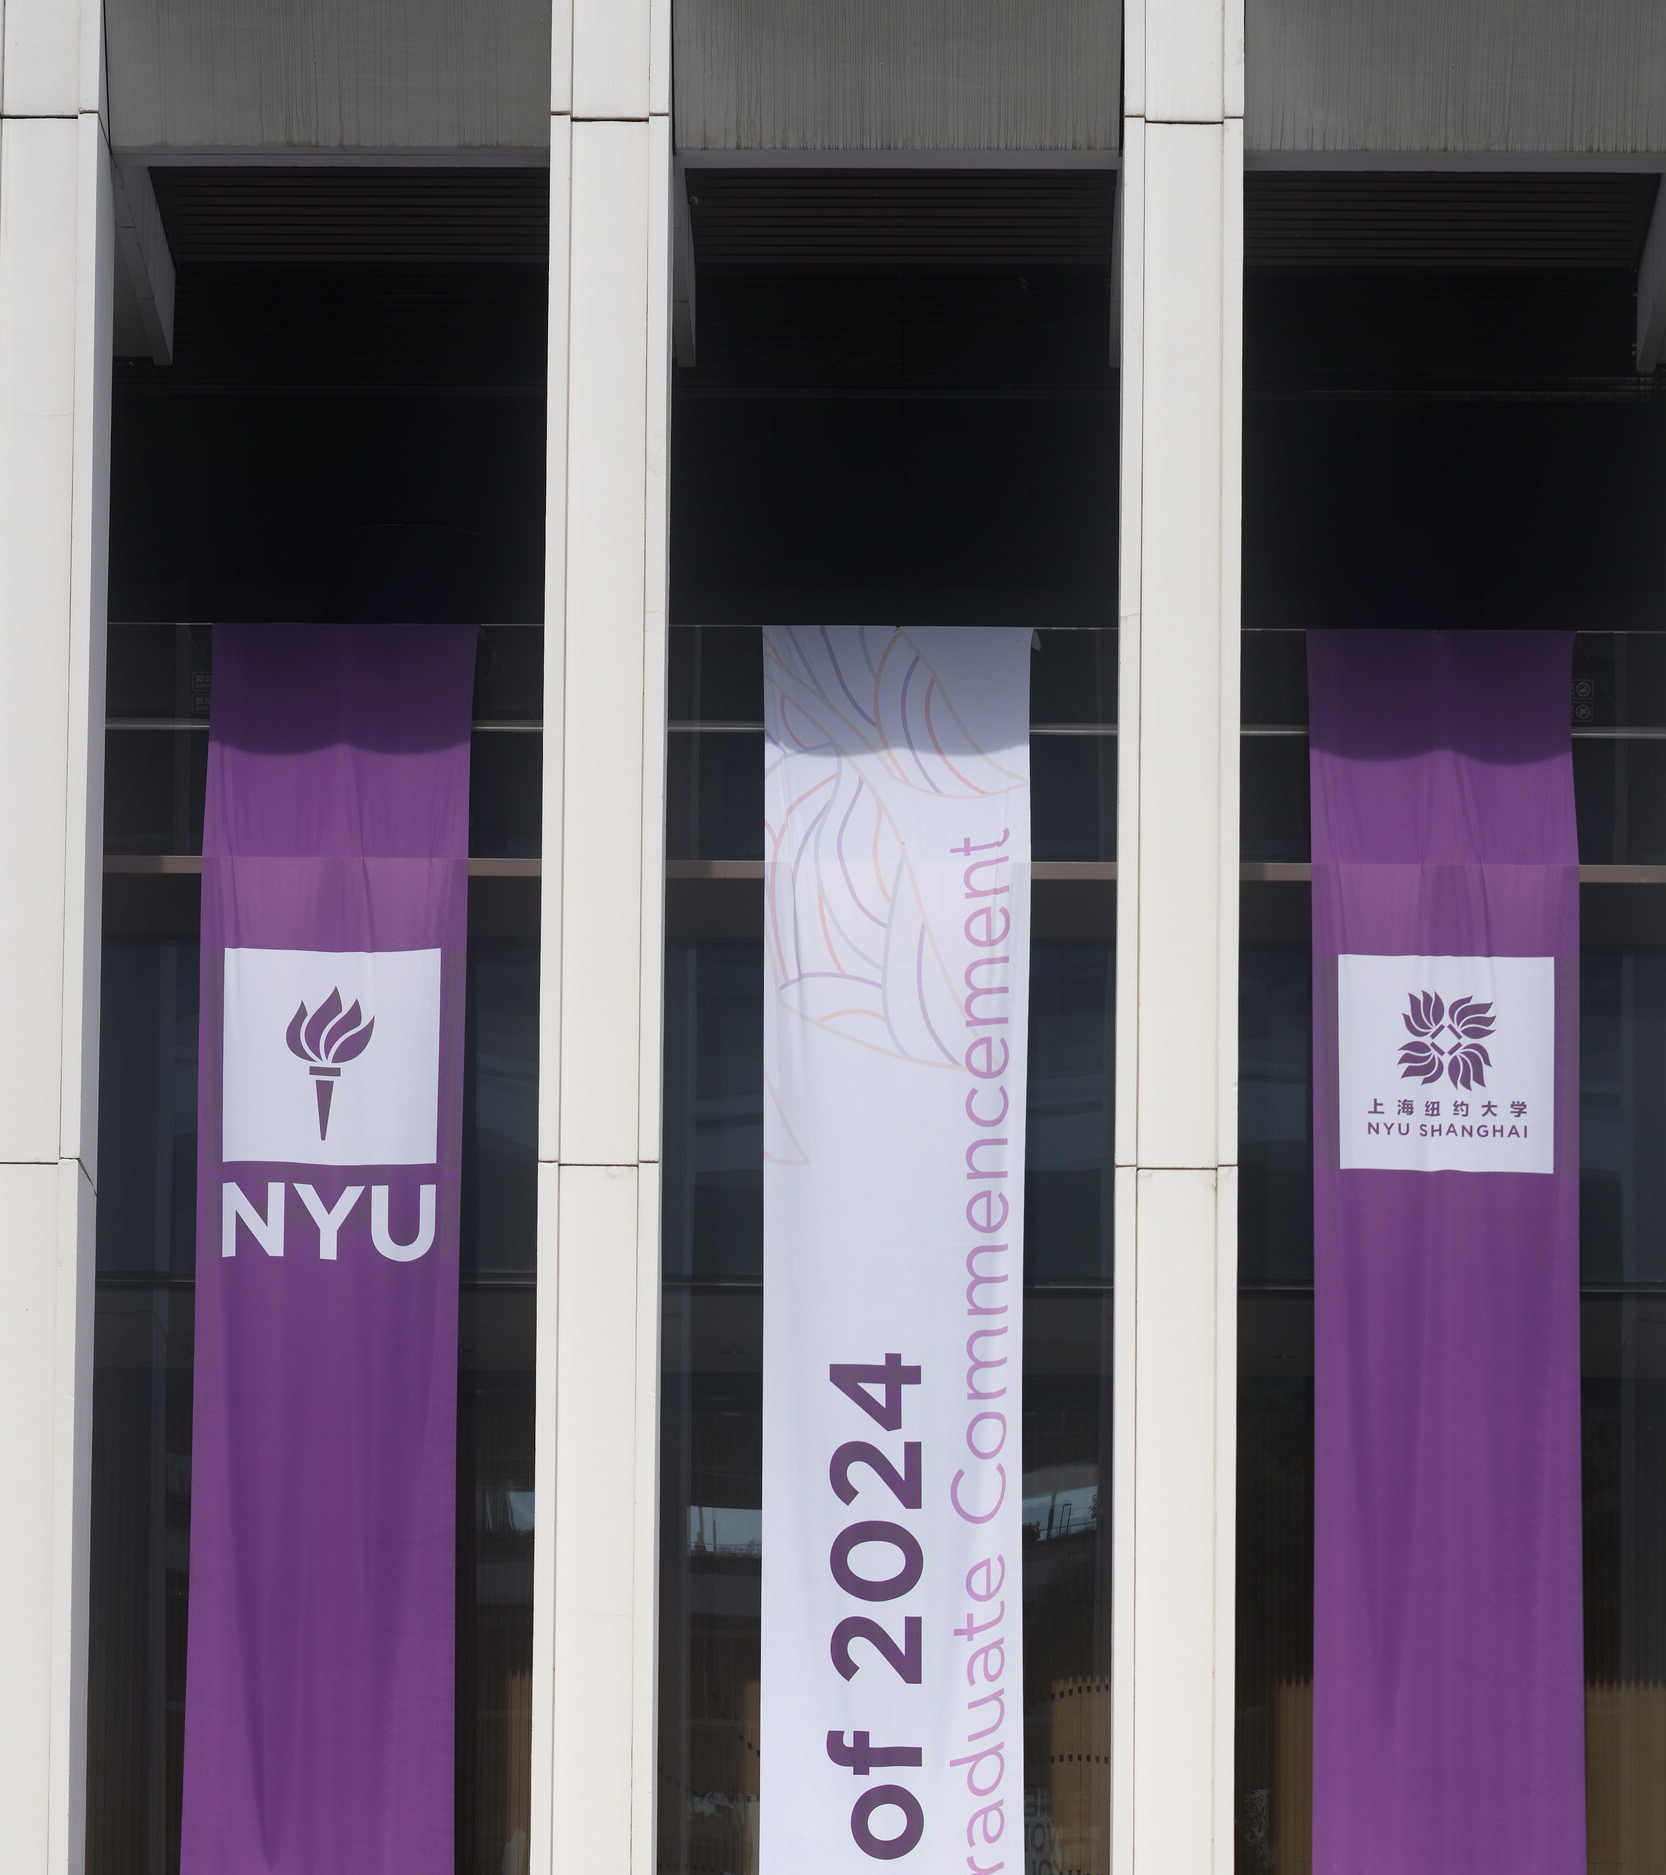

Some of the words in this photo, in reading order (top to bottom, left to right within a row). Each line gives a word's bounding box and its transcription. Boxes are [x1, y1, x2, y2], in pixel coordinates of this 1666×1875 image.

[1367, 1098, 1528, 1118] 上海纽约大学
[1367, 1122, 1411, 1137] NYU
[1419, 1123, 1528, 1139] SHANGHAI
[222, 1181, 437, 1262] NYU
[949, 827, 1011, 1526] Commencement
[829, 1352, 925, 1686] 2024
[826, 1729, 926, 1861] of
